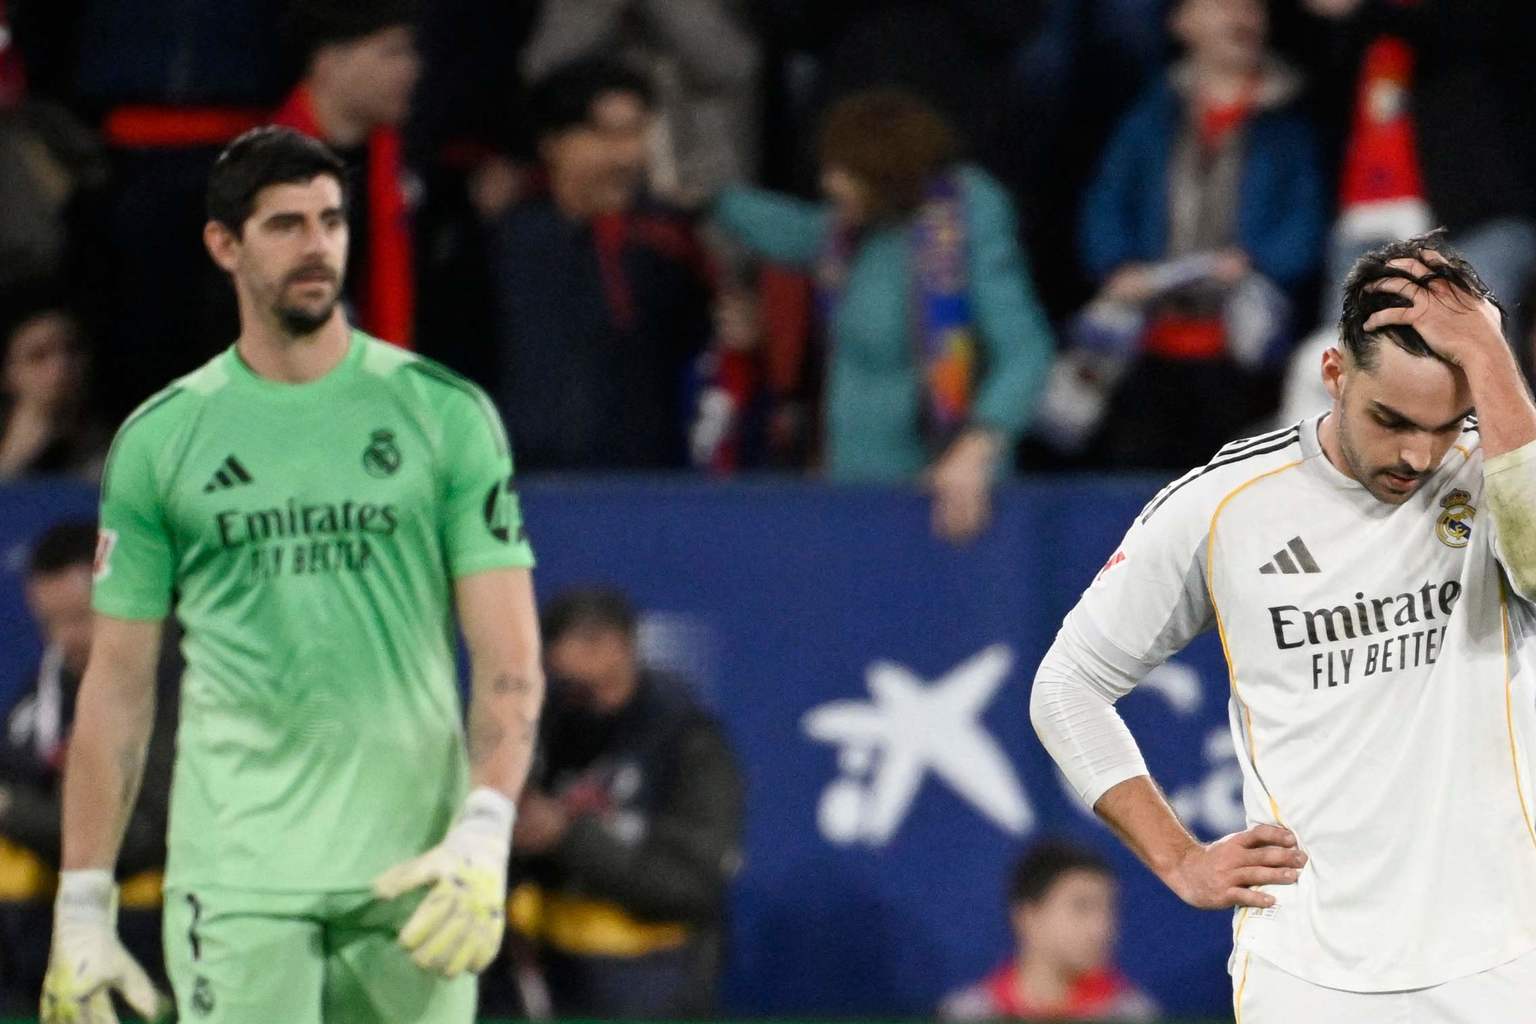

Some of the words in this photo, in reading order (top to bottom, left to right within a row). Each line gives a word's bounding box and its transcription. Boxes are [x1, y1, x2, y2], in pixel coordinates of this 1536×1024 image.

[216, 497, 398, 548] Emirates
[1267, 579, 1462, 650] Emirate
[1312, 648, 1354, 690] FLY
